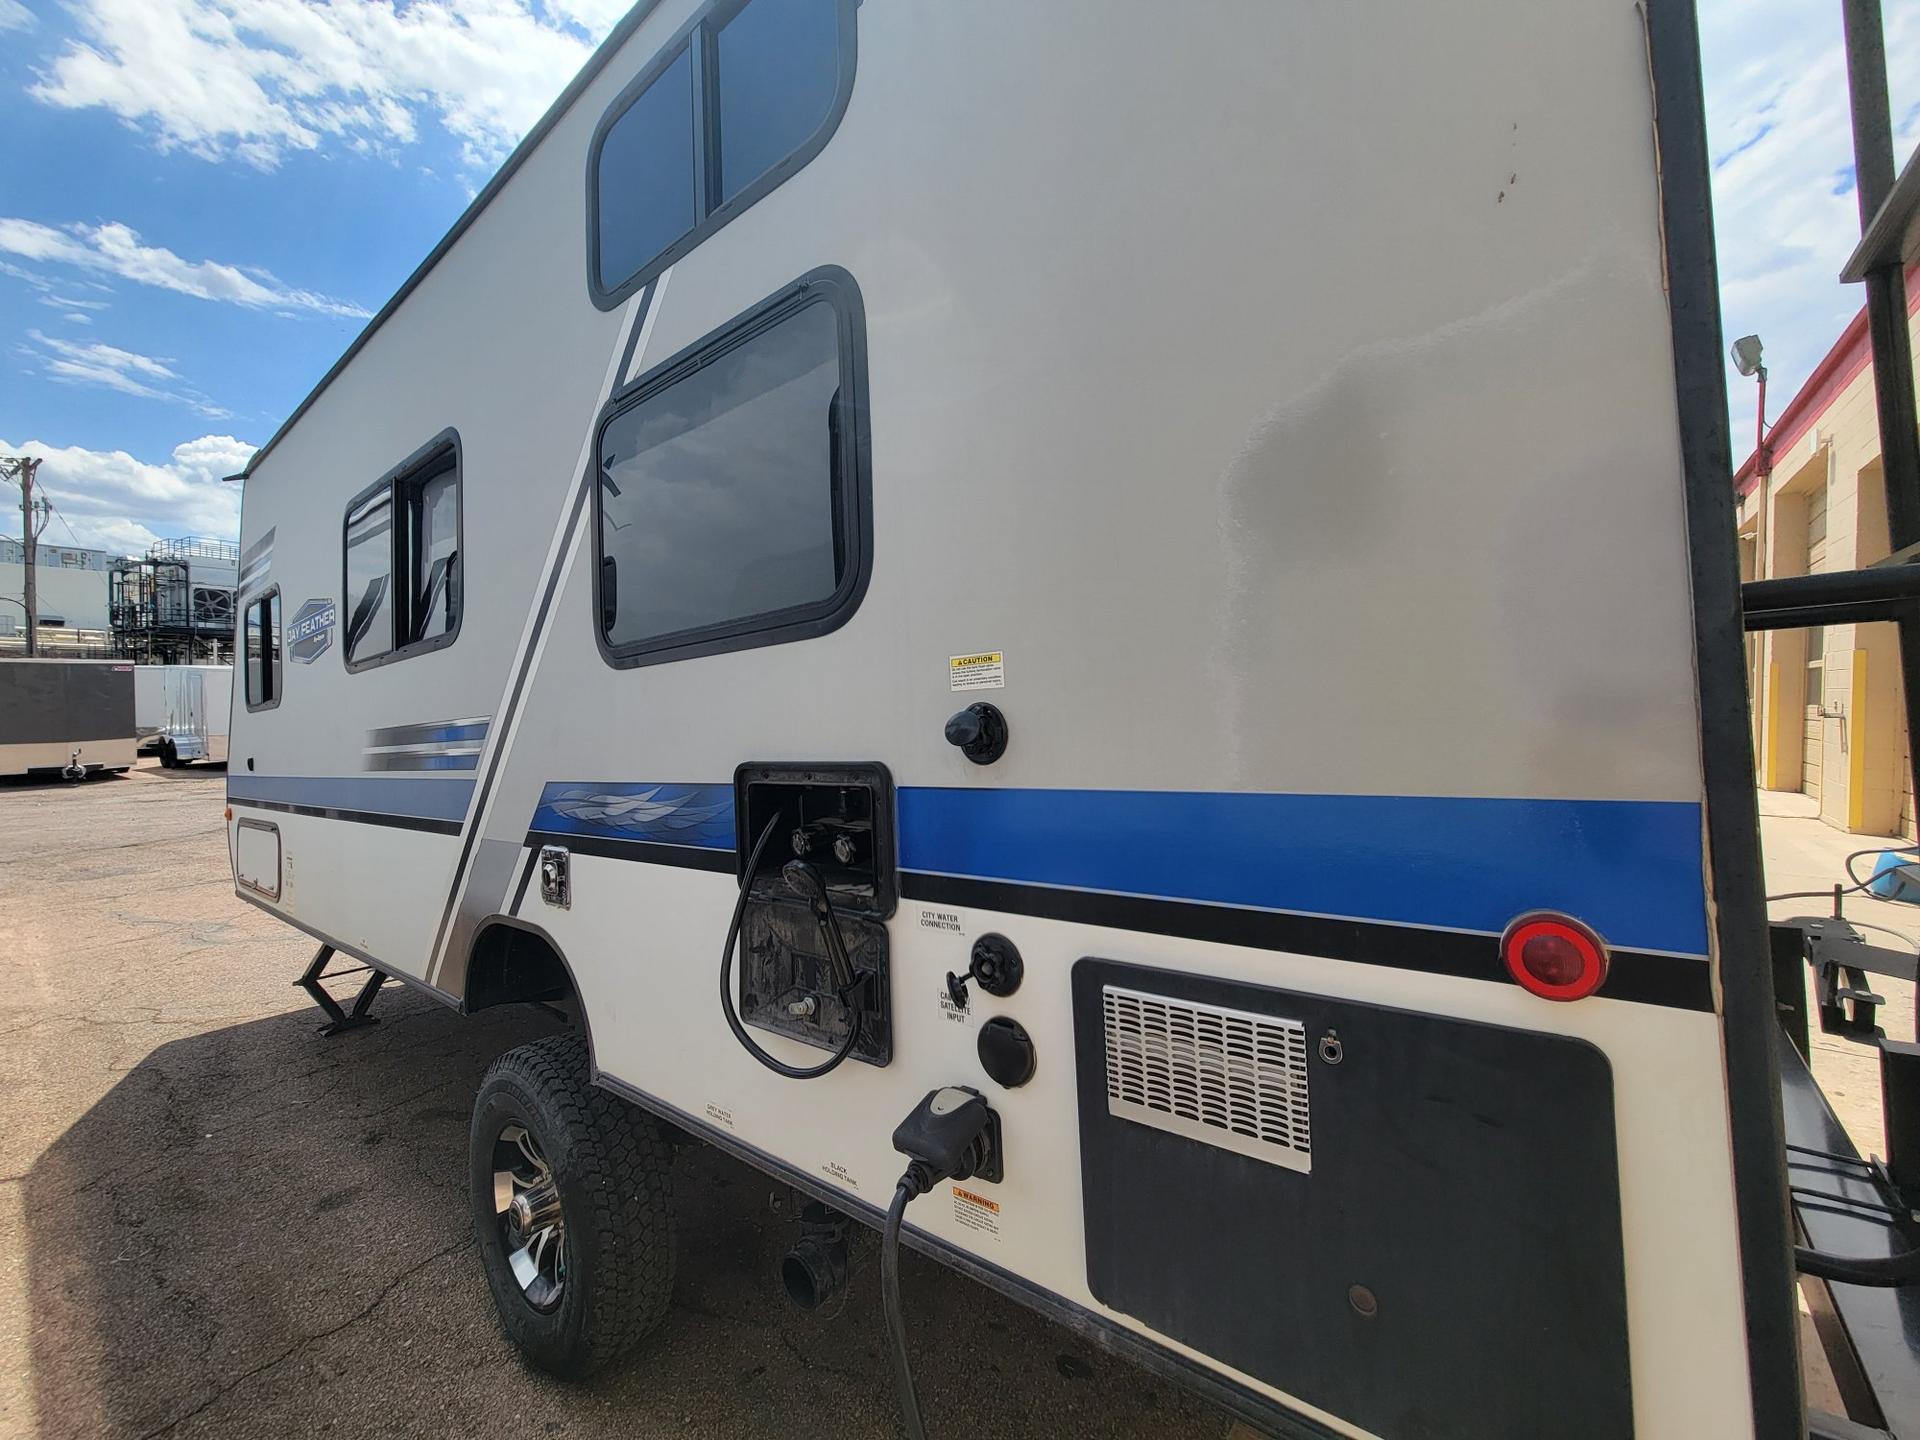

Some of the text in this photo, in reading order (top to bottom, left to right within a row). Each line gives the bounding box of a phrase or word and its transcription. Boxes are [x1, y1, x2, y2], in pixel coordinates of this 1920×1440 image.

[288, 609, 335, 643] JAY FEATHER
[963, 655, 993, 665] CAUTION
[921, 911, 958, 922] CITY WATER
[920, 919, 961, 931] CONNECTION
[946, 1011, 965, 1023] INPUT
[830, 1161, 848, 1175] BLACK
[822, 1165, 858, 1187] HOLDING TANK
[963, 1191, 995, 1210] WARNING
